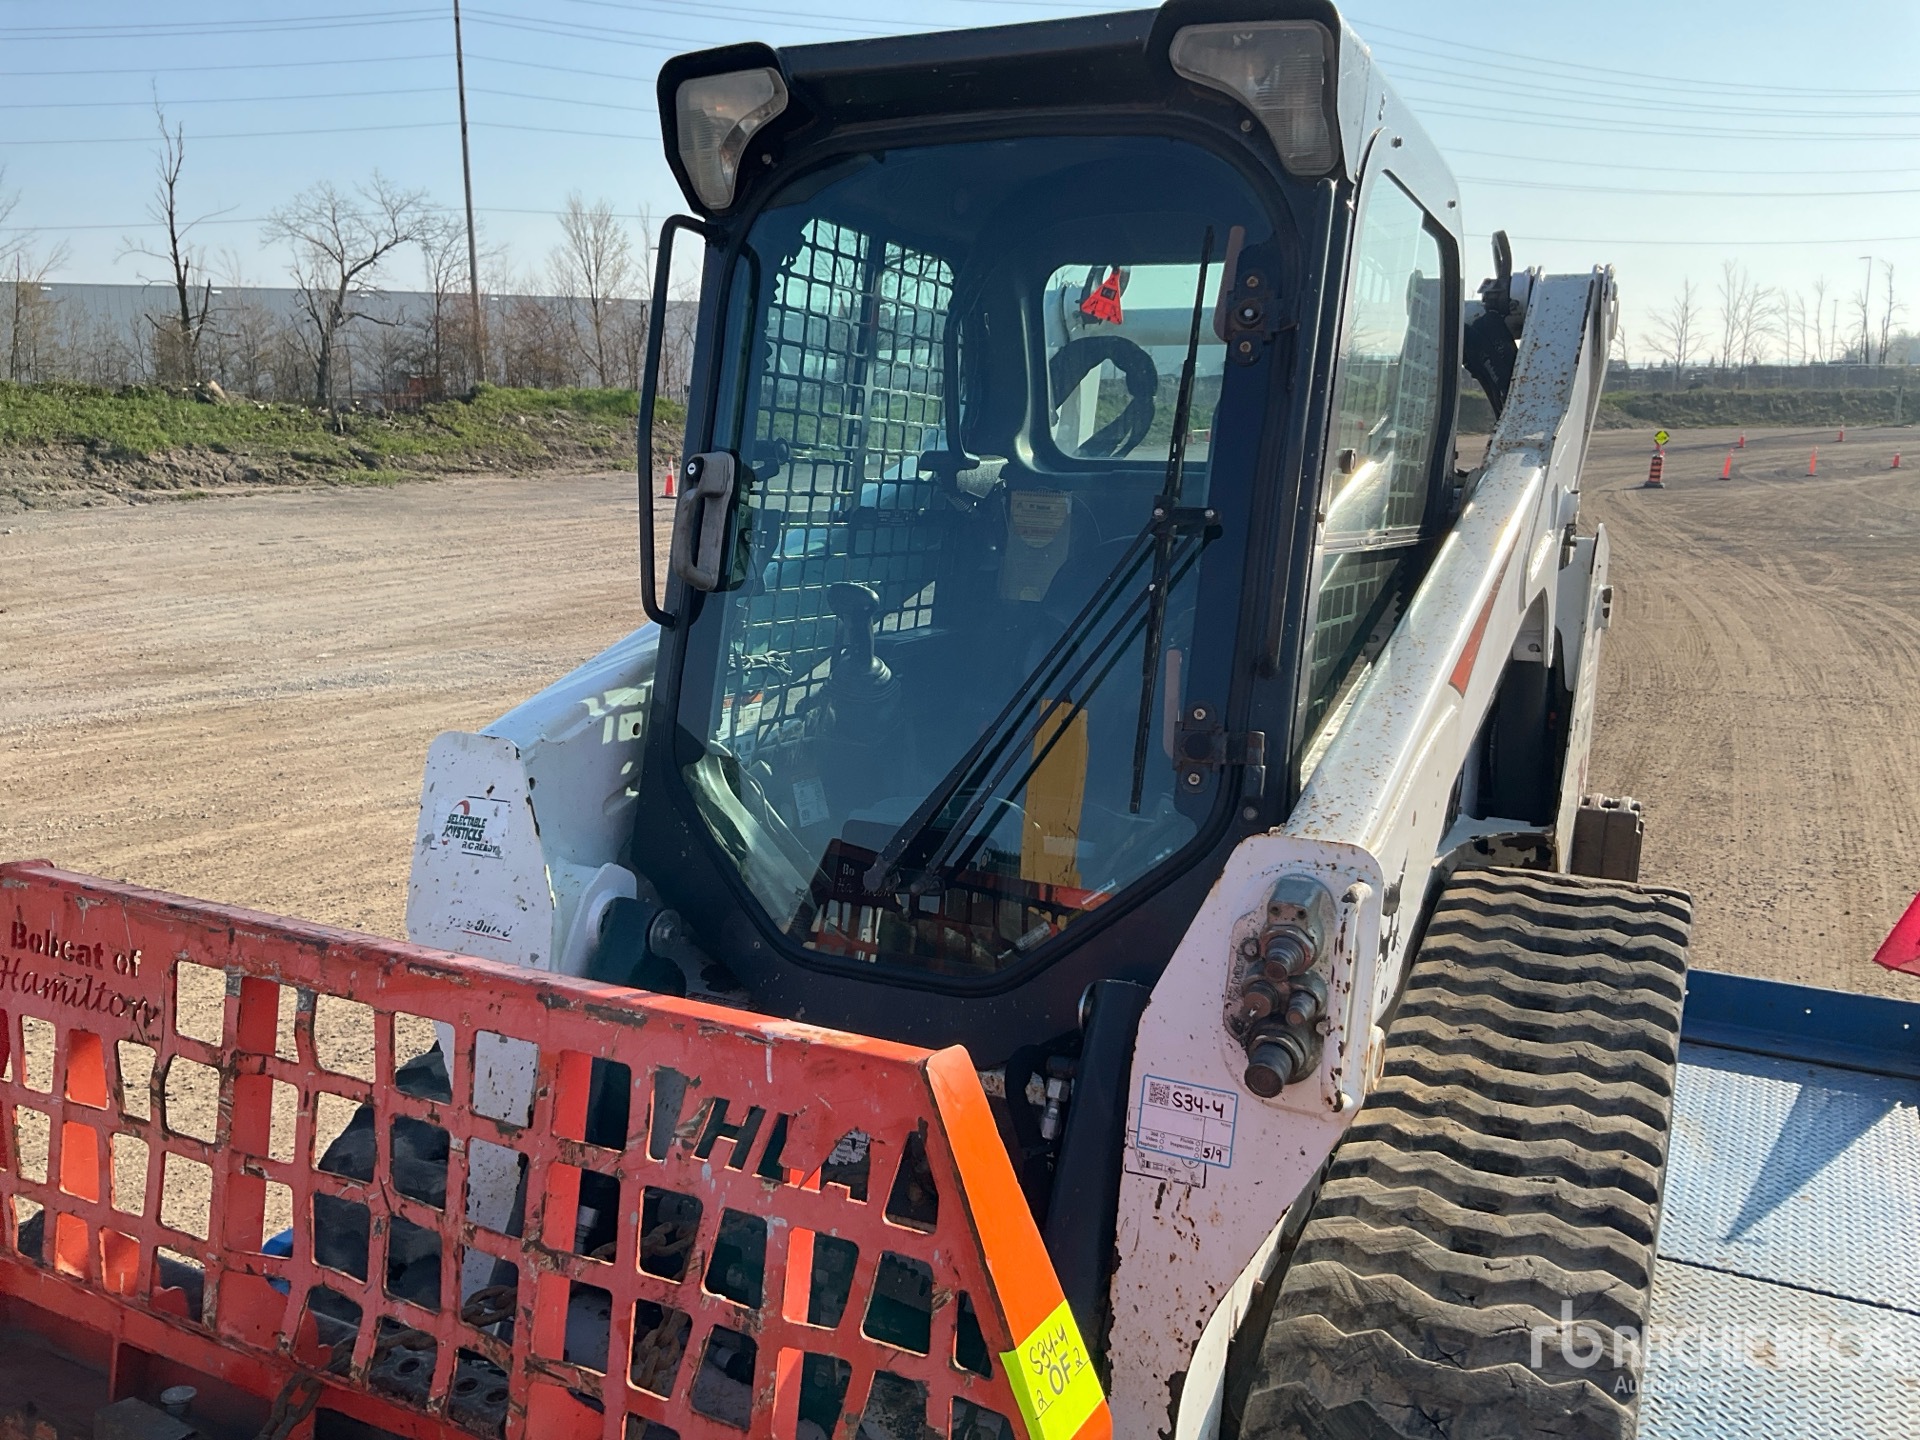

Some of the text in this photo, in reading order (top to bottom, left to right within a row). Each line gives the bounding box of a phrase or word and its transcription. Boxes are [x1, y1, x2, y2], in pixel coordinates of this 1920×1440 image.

[11, 921, 142, 977] Bobcat of
[0, 955, 160, 1029] Hamilton
[1171, 1091, 1224, 1119] S34-4
[1203, 1146, 1222, 1162] 5/9
[1049, 1351, 1071, 1395] OF
